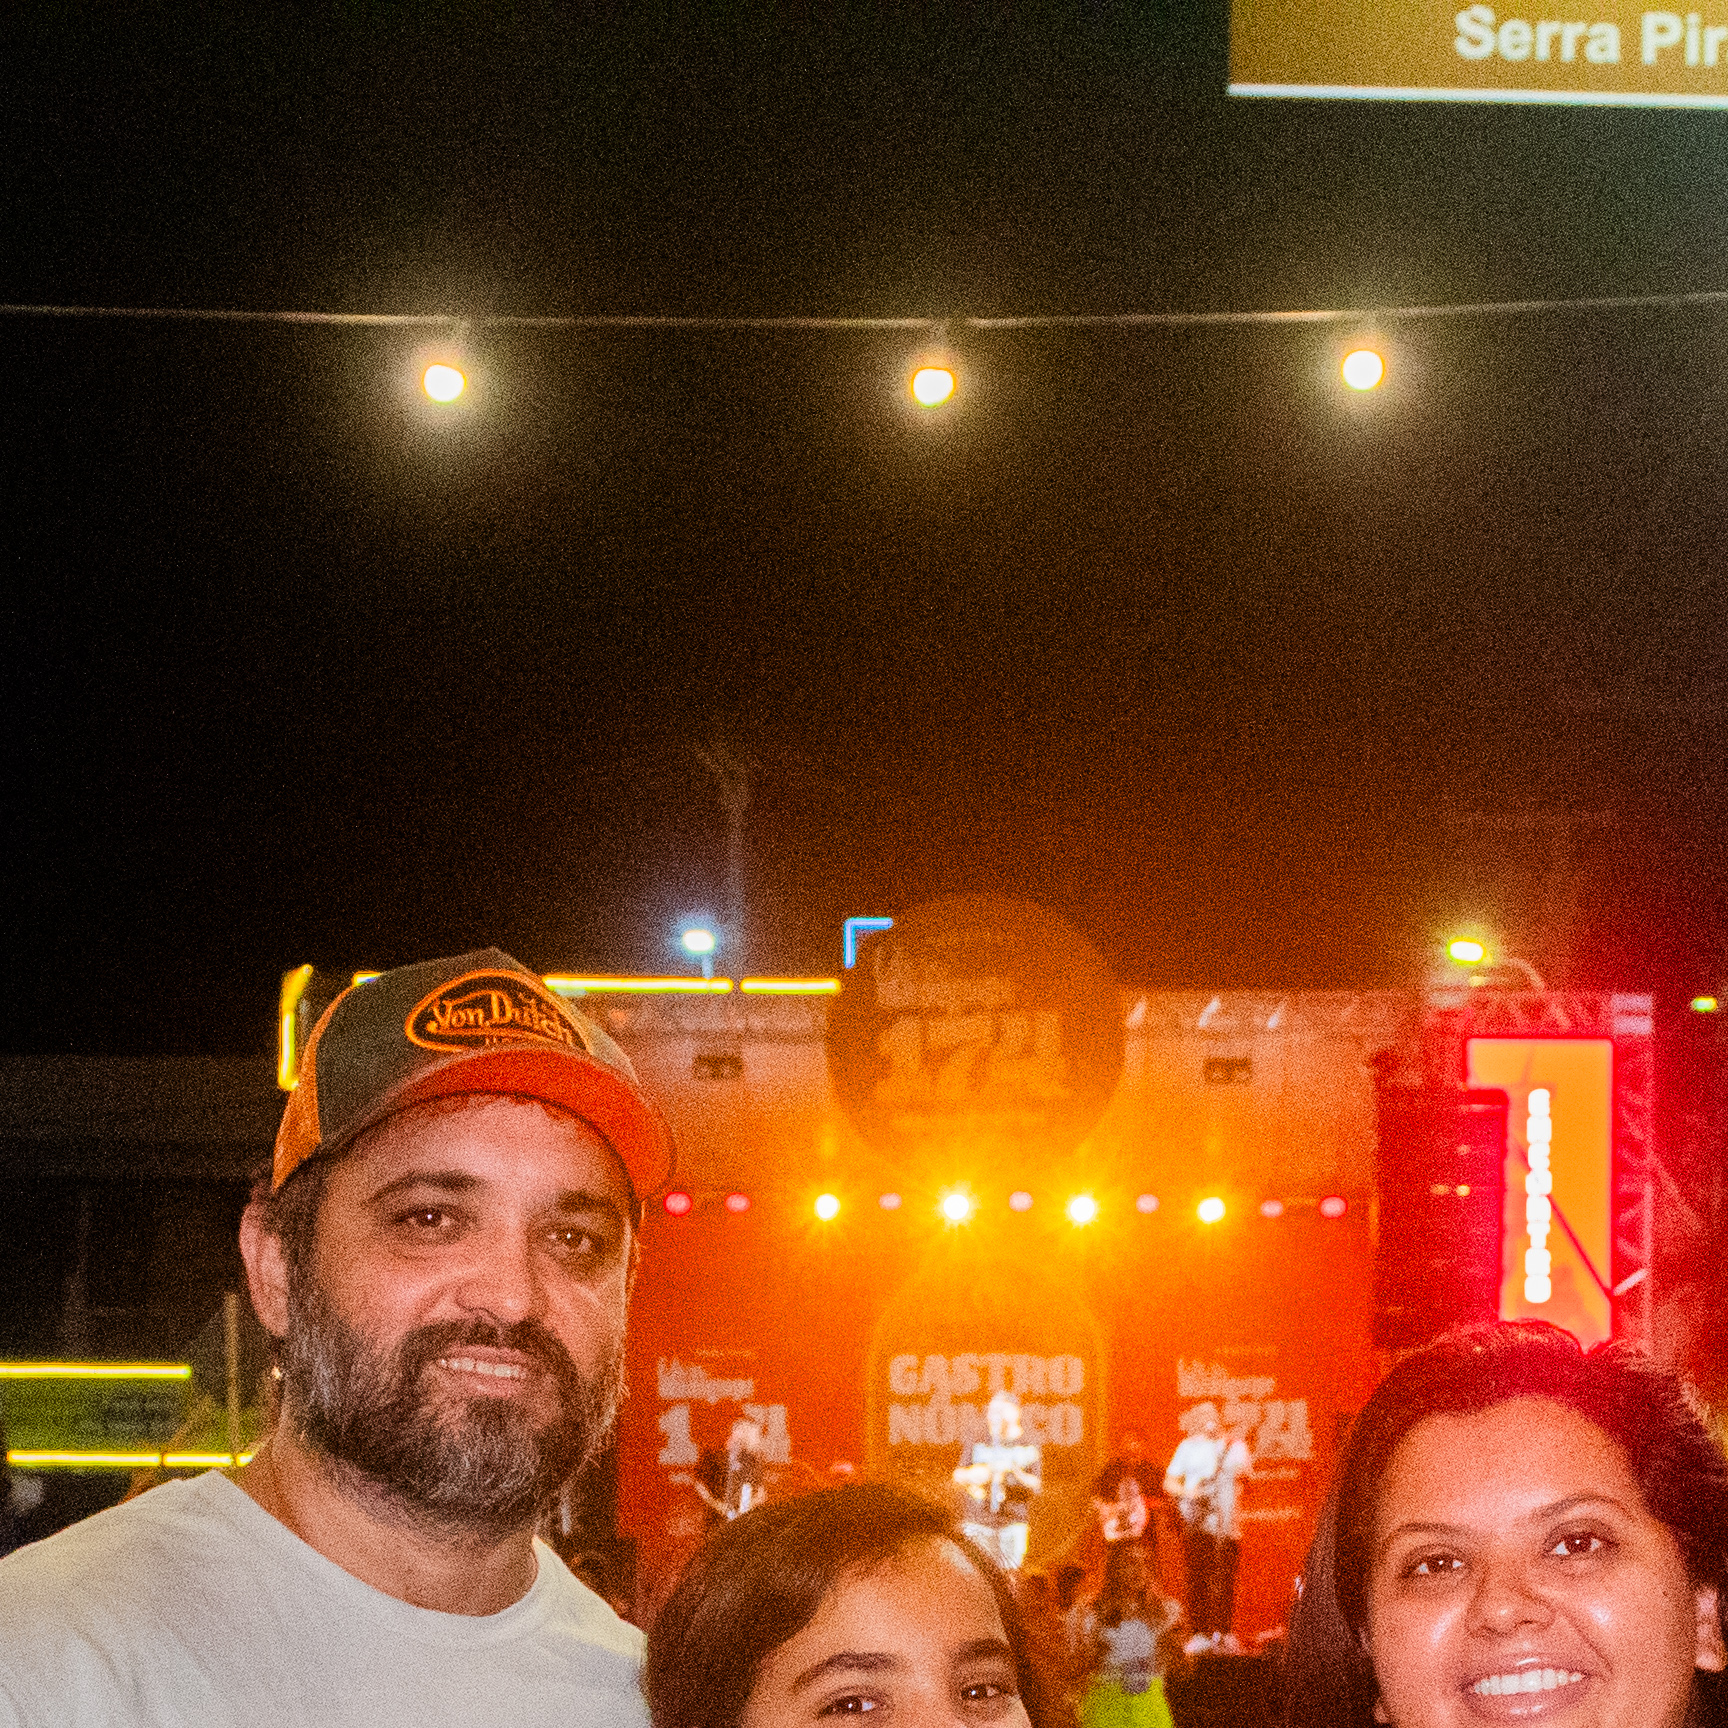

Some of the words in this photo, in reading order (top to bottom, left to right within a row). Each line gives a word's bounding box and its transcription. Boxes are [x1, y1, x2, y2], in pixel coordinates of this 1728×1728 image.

[1455, 8, 1620, 63] Serra
[427, 999, 485, 1031] Von
[487, 989, 574, 1046] Dutch
[888, 1352, 1084, 1395] GASTRO
[888, 1396, 1084, 1445] NÓMCO
